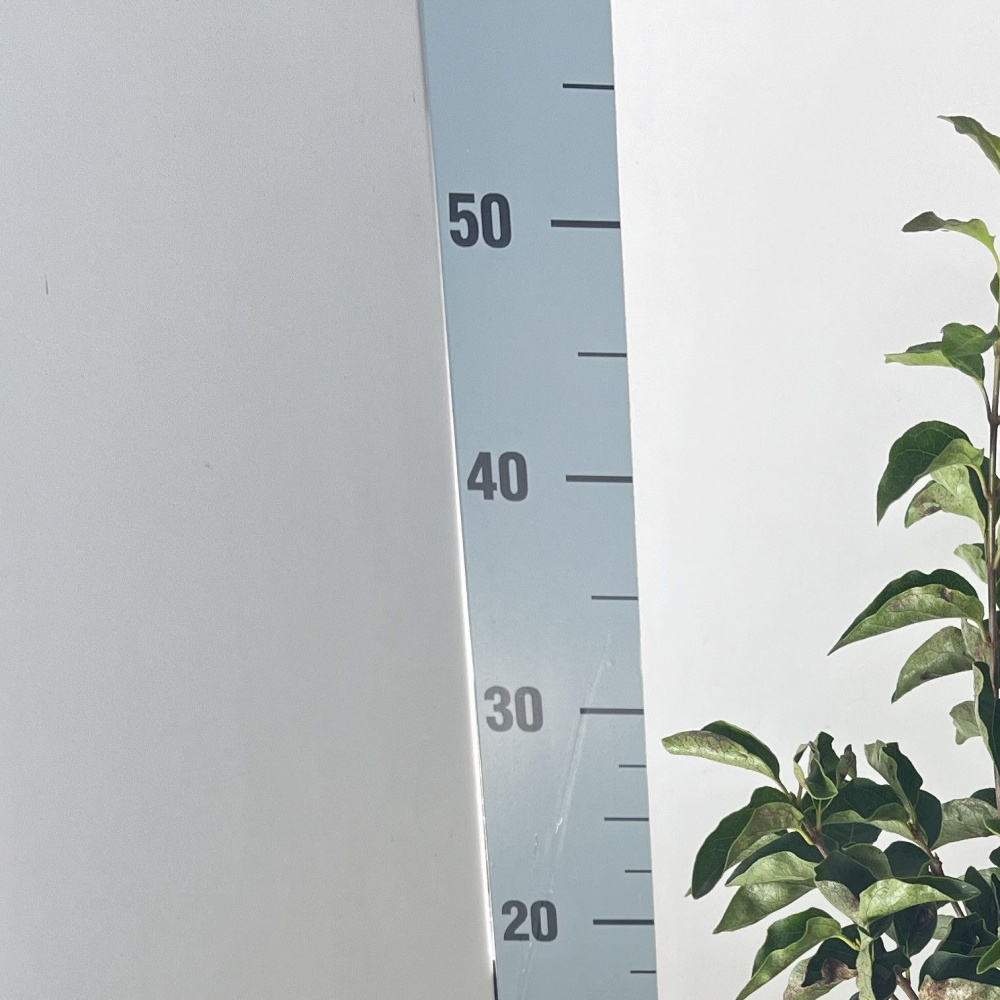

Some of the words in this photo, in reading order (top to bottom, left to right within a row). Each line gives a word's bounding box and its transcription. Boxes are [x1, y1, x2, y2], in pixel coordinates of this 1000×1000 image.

[448, 192, 513, 249] 50
[466, 450, 529, 503] 40
[483, 685, 544, 734] 30
[502, 899, 559, 943] 20
